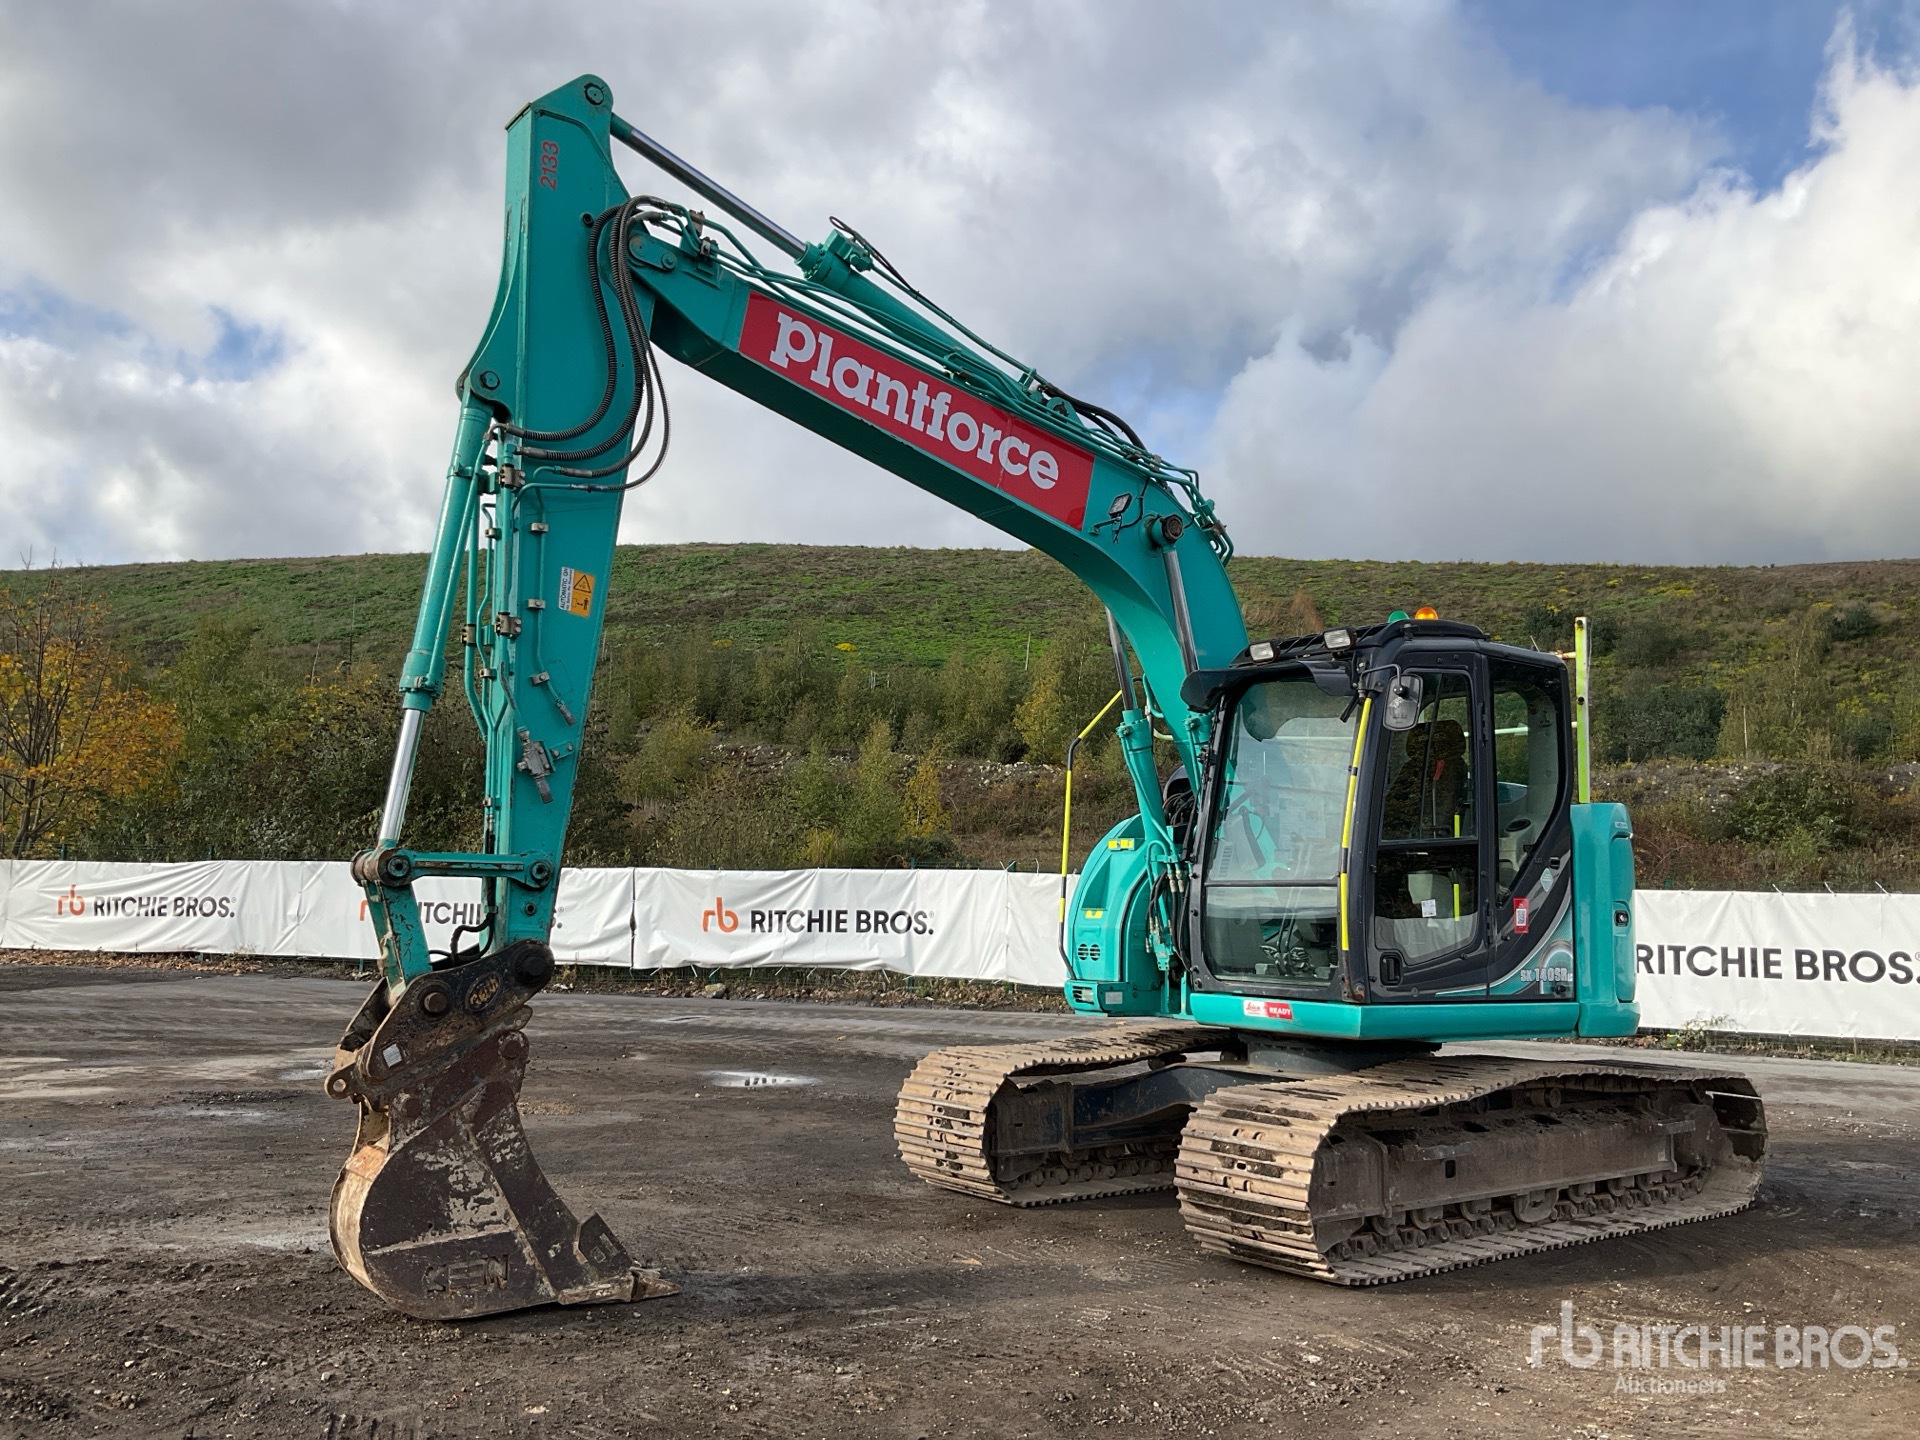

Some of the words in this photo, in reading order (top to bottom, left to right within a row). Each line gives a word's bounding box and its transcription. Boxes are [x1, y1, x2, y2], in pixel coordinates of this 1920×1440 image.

[540, 141, 560, 191] 2133
[769, 311, 1060, 490] plantforce
[57, 884, 86, 916] rb
[93, 896, 168, 917] RITCHIE
[172, 896, 236, 918] BROS.
[702, 896, 739, 933] rb
[750, 909, 849, 933] RITCHIE
[855, 909, 934, 935] BROS.
[1636, 944, 1783, 980] RITCHIE
[1269, 1006, 1291, 1015] READY
